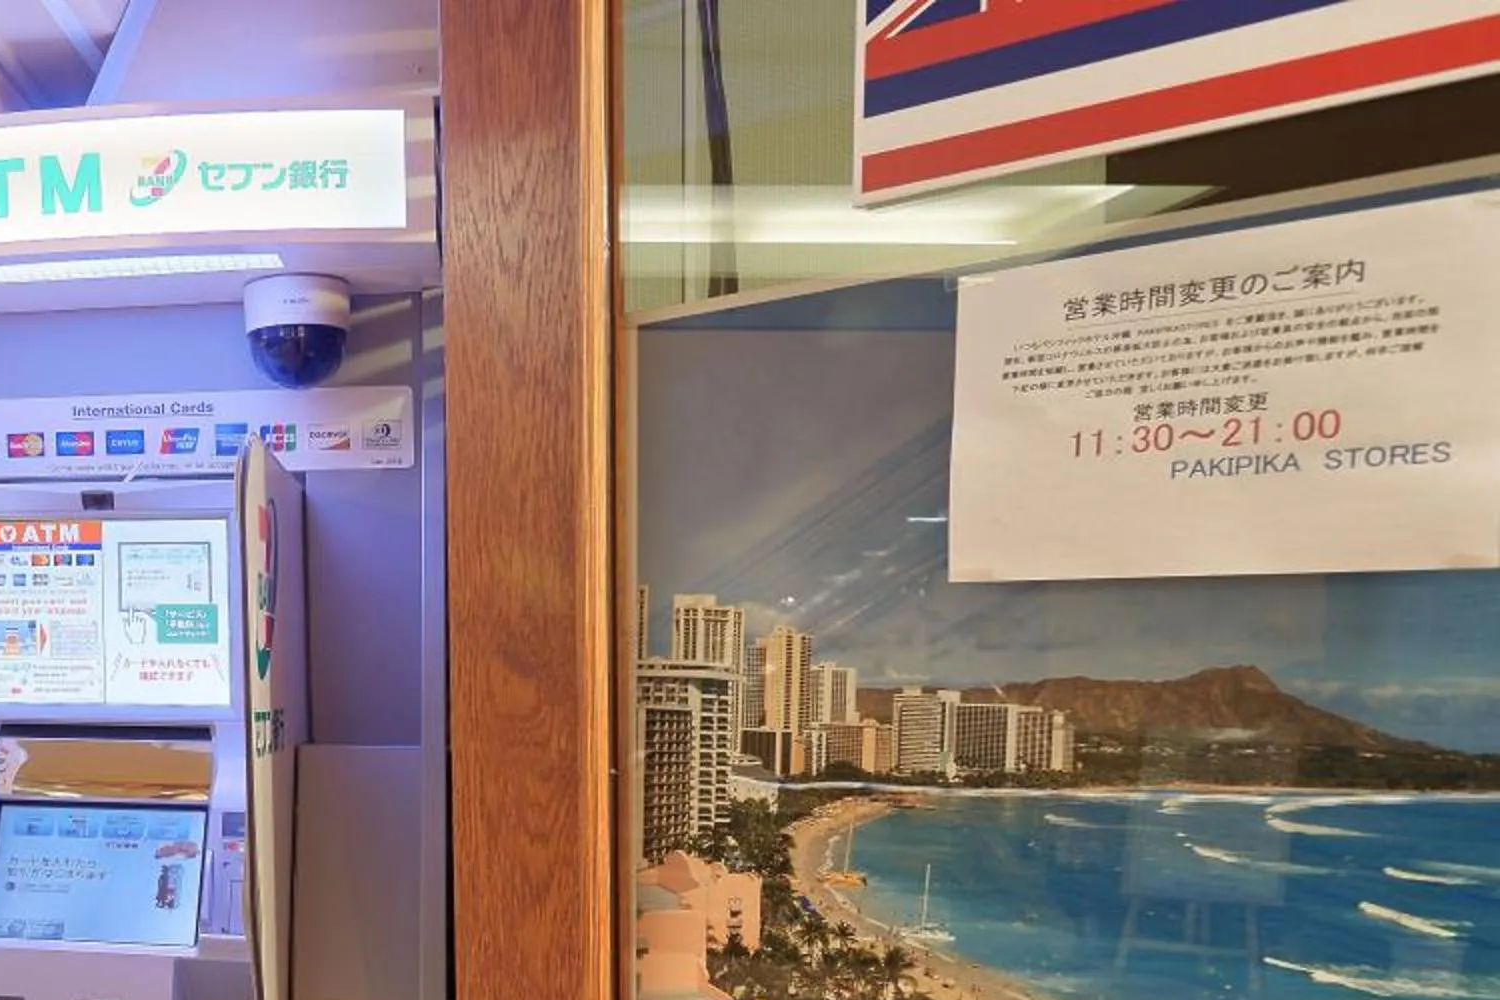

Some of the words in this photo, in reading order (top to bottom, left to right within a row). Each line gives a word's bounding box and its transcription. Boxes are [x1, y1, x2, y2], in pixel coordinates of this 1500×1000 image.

[198, 158, 350, 192] セブン銀行
[1063, 258, 1367, 322] 営業時間変更のご案内
[73, 402, 165, 418] International
[170, 401, 215, 415] Cards
[1133, 392, 1269, 422] 営業時間変更
[1171, 451, 1300, 480] PAKIPIKA
[1324, 442, 1451, 470] STORES
[21, 524, 80, 543] ATM
